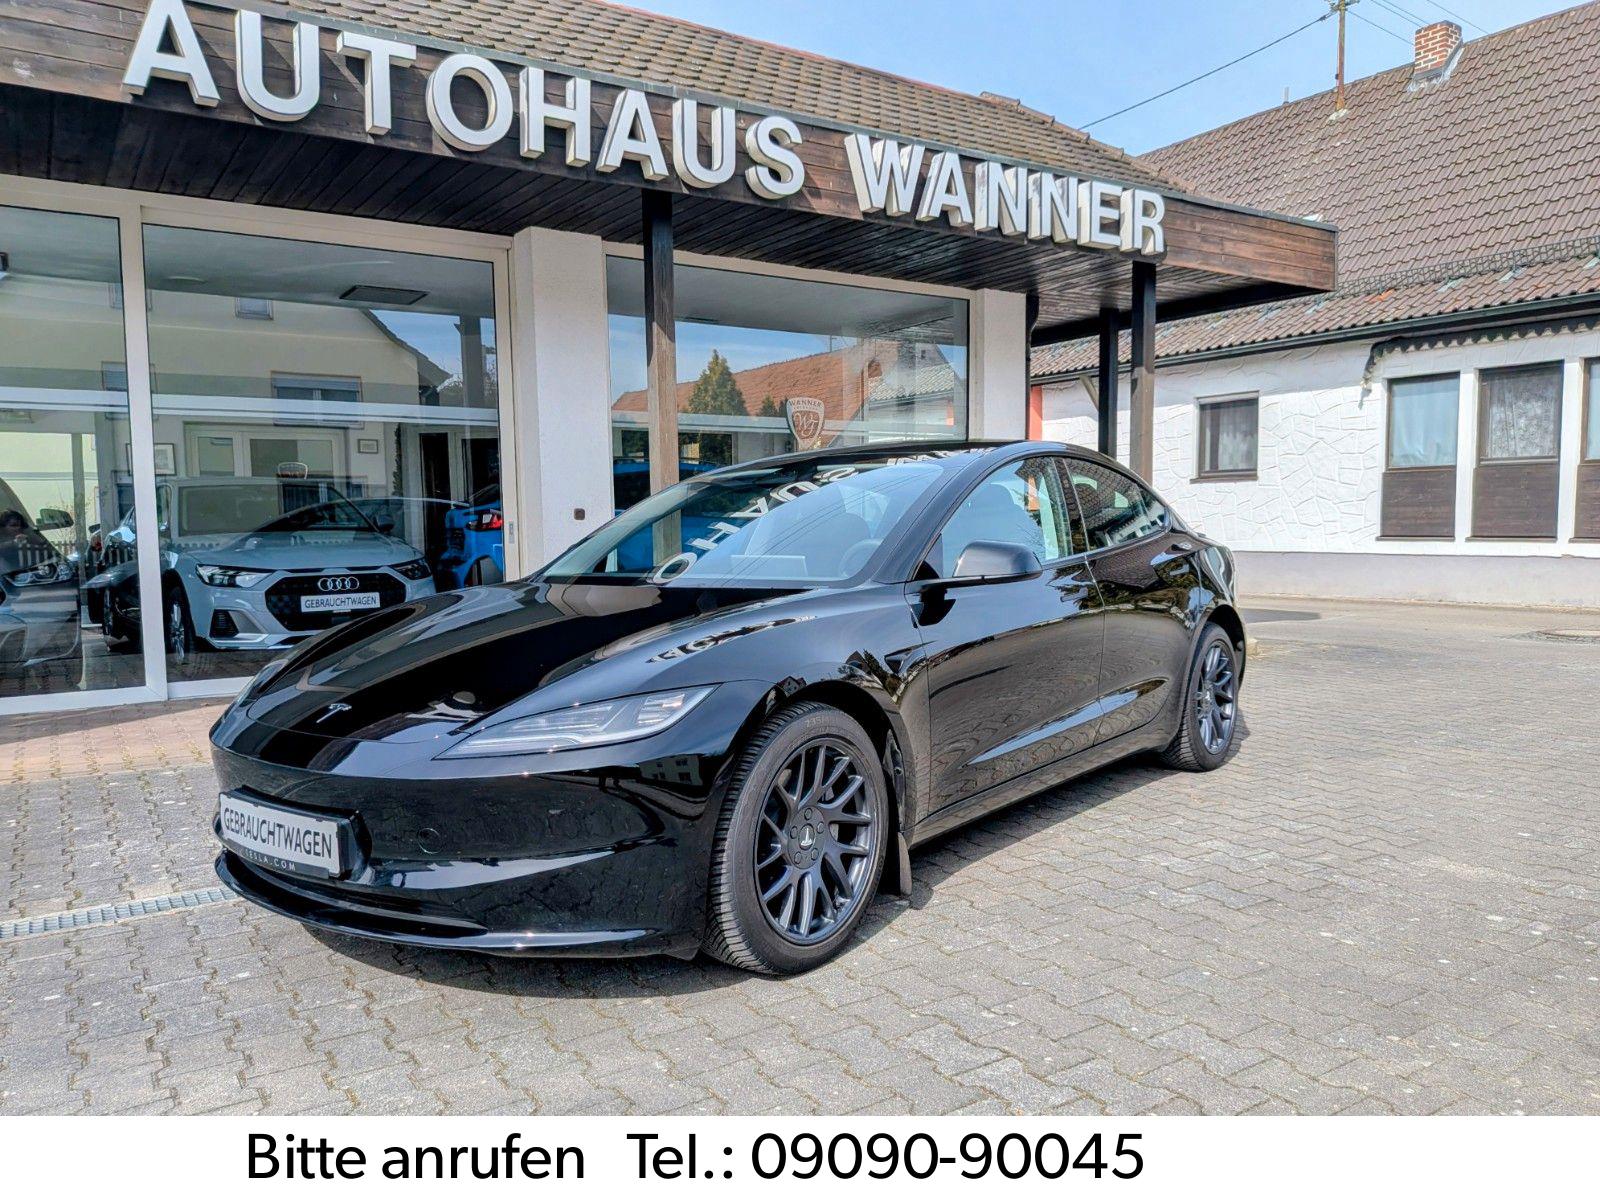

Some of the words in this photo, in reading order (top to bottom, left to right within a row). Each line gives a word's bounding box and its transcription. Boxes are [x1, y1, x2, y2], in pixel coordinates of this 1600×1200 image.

[122, 0, 804, 199] AUTOHAUS
[844, 132, 1165, 256] WANNER
[304, 596, 377, 608] GEBRAUCHTWAGEN
[223, 807, 332, 859] GEBRAUCHTWAGEN
